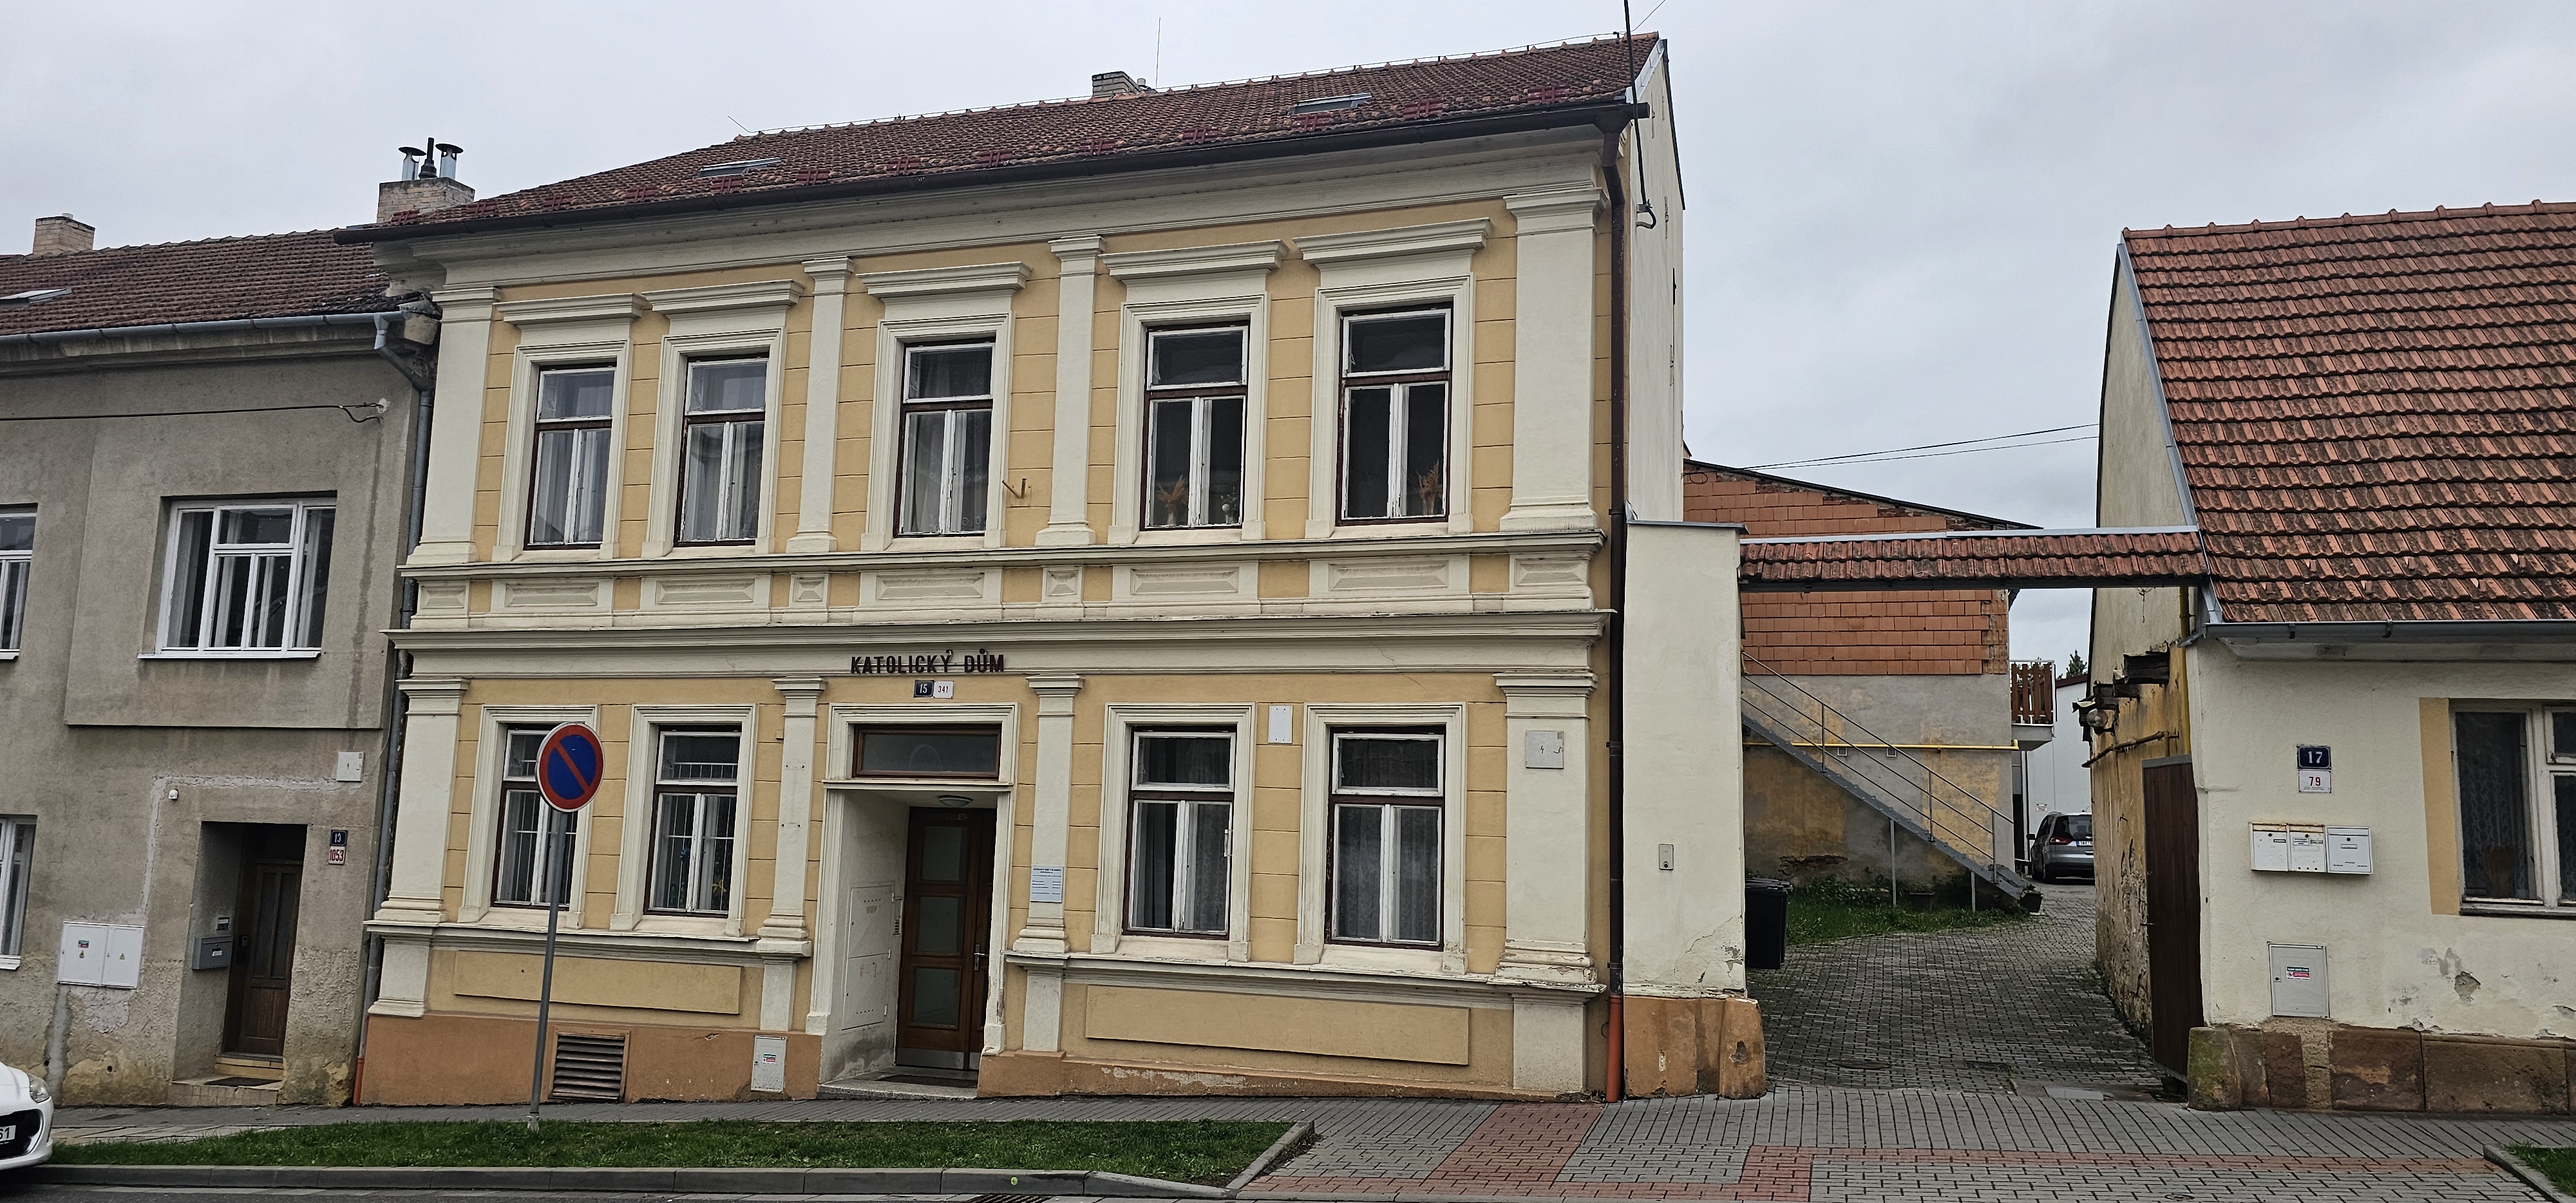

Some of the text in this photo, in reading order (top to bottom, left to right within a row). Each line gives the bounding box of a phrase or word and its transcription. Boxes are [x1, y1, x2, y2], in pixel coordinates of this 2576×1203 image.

[851, 649, 1004, 674] KATOLICKÝ DŮM
[919, 683, 928, 694] 15
[2307, 751, 2323, 764] 17
[2309, 777, 2320, 786] 79
[334, 833, 341, 843] 13
[330, 849, 344, 862] 1053
